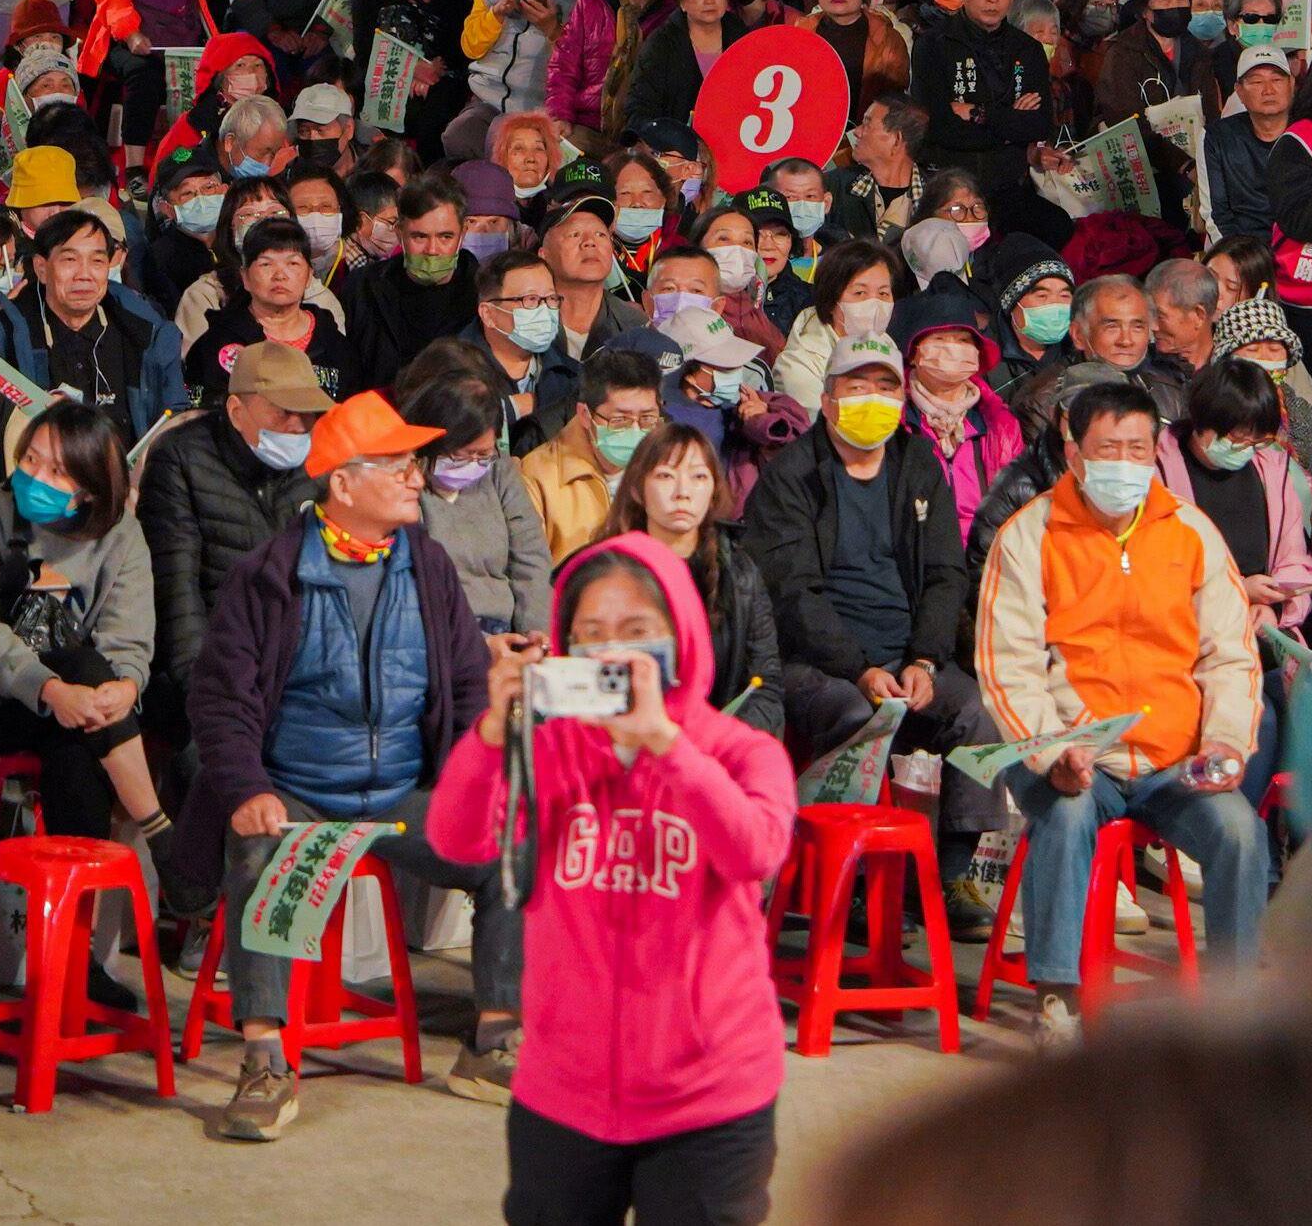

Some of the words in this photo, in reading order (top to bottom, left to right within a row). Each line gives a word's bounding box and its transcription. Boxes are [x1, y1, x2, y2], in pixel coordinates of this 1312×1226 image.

[739, 64, 802, 155] 3
[707, 317, 726, 334] 林俊
[851, 340, 891, 355] 林俊憲
[554, 802, 697, 900] GAP
